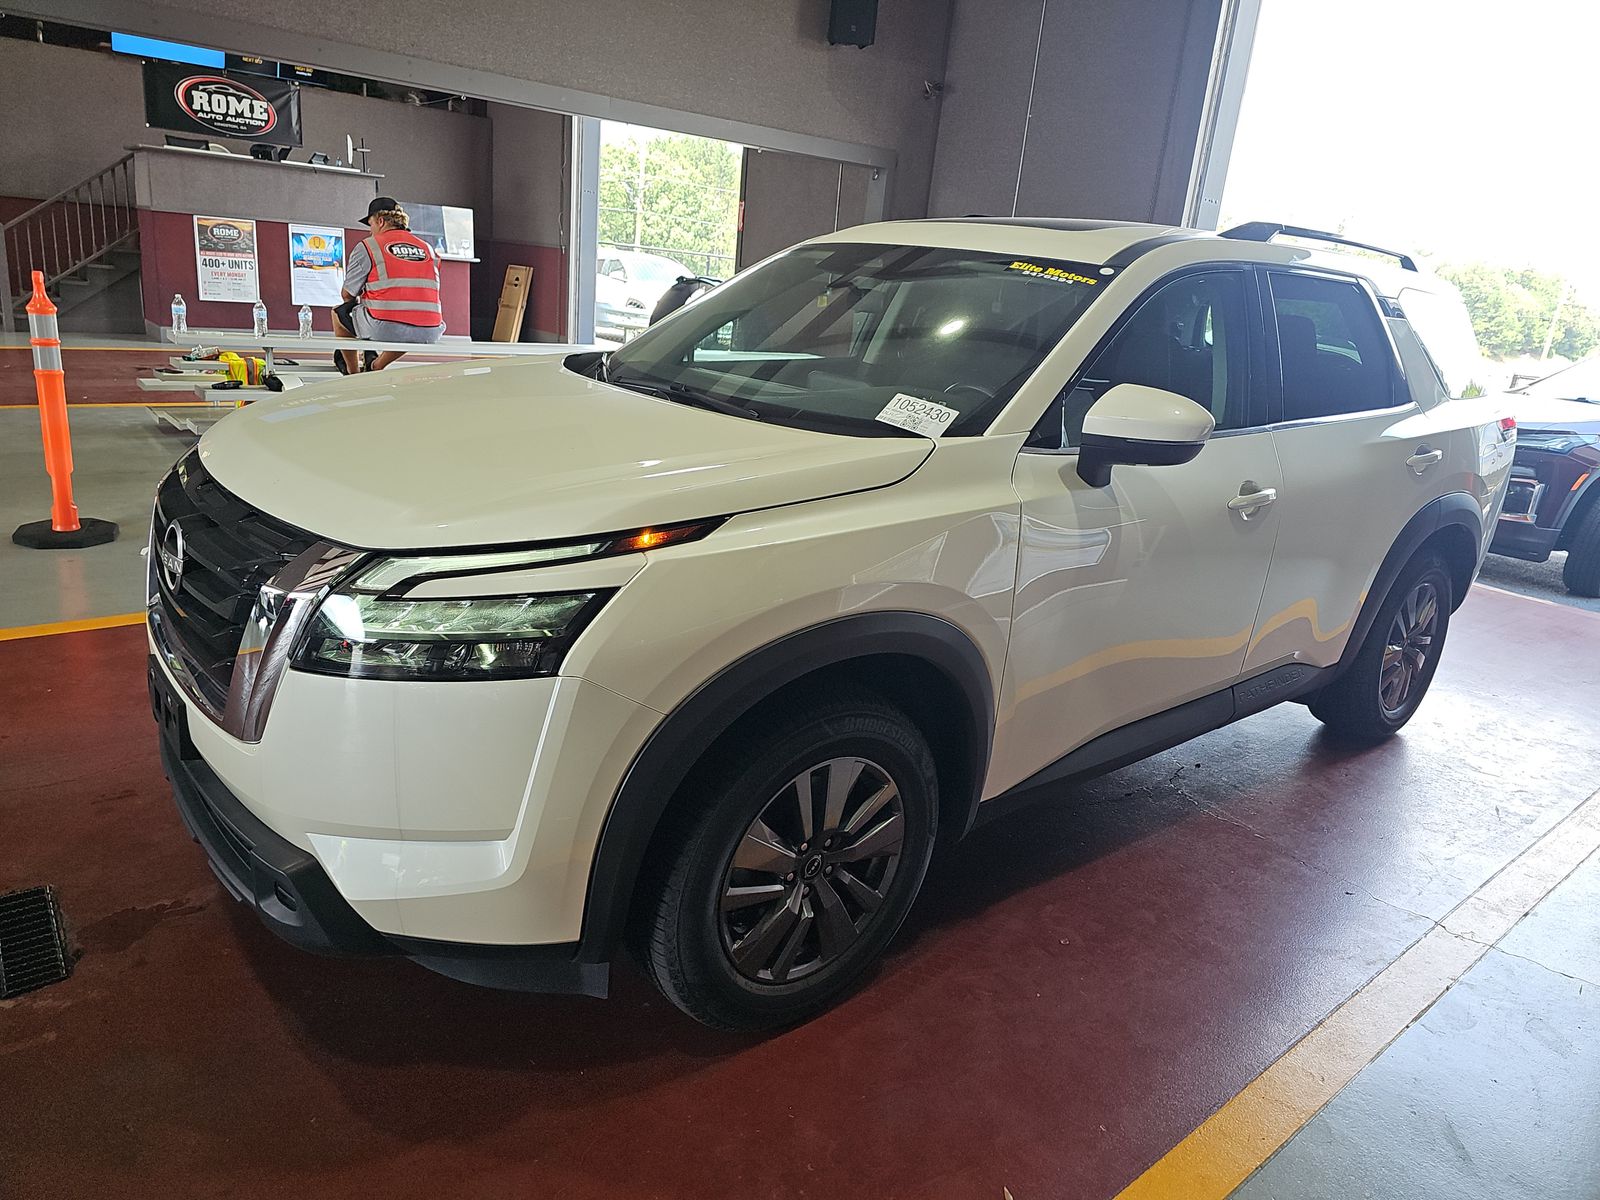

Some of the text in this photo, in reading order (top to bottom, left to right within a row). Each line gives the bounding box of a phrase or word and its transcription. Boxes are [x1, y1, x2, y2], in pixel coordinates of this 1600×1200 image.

[191, 90, 268, 120] ROME
[197, 111, 266, 127] AUTO AUCTION
[213, 227, 240, 237] ROME
[391, 246, 426, 256] ROME
[202, 257, 254, 270] 400+ UNITS
[1009, 261, 1098, 285] Elite Motors
[893, 397, 951, 423] 1052430
[1240, 668, 1305, 703] PATHFINDER
